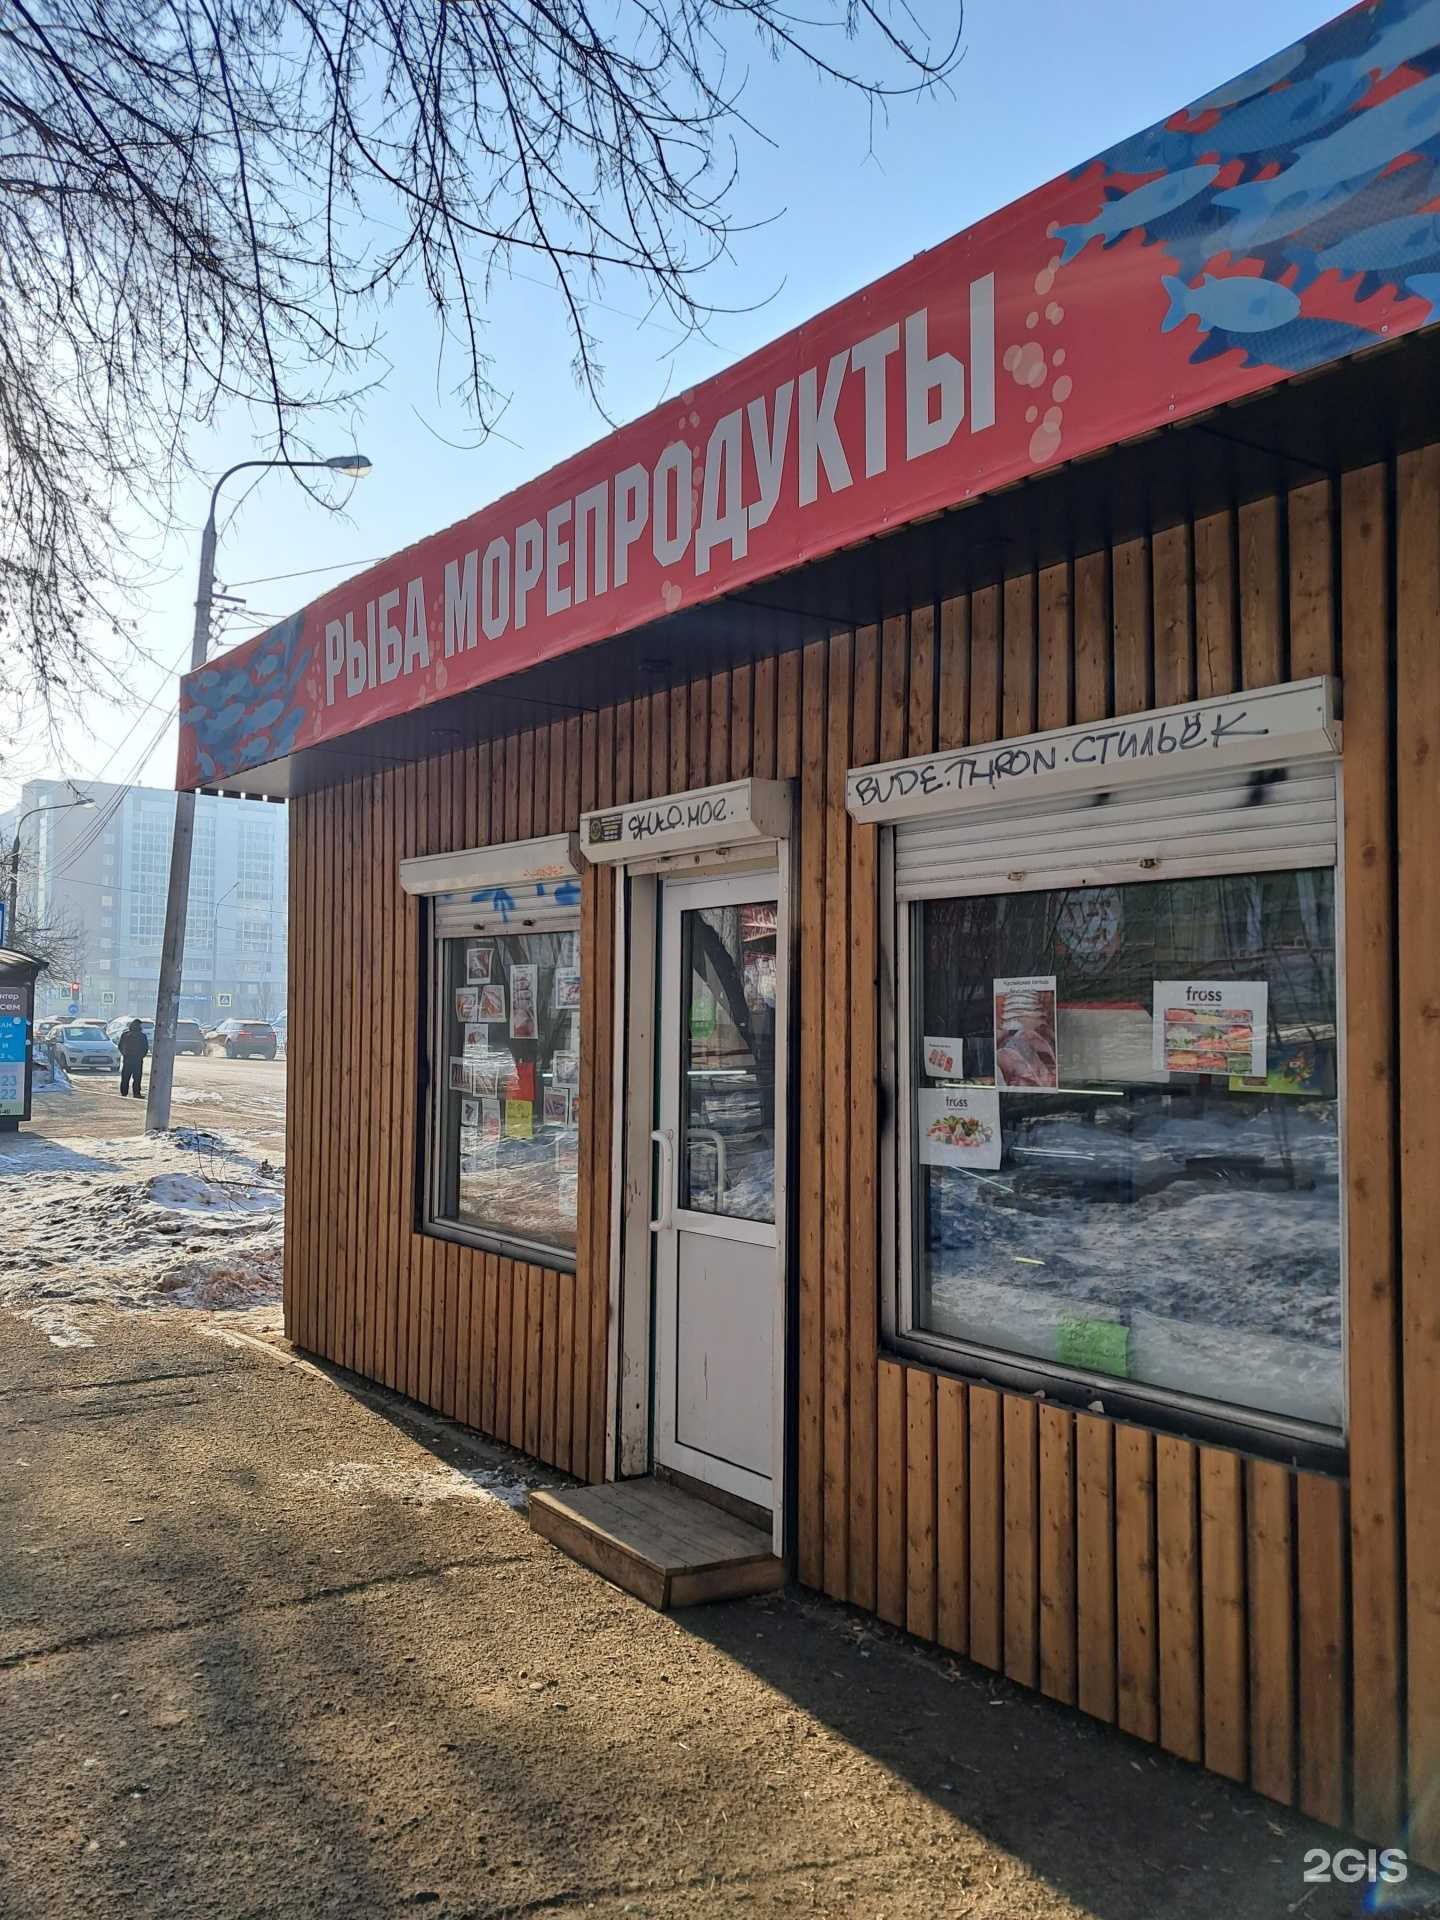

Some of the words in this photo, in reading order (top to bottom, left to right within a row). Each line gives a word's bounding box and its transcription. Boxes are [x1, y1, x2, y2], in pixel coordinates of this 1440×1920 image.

[325, 576, 430, 705] РЫБА
[444, 272, 996, 658] МОРЕПРОДУКТЫ
[1186, 986, 1222, 1001] fross
